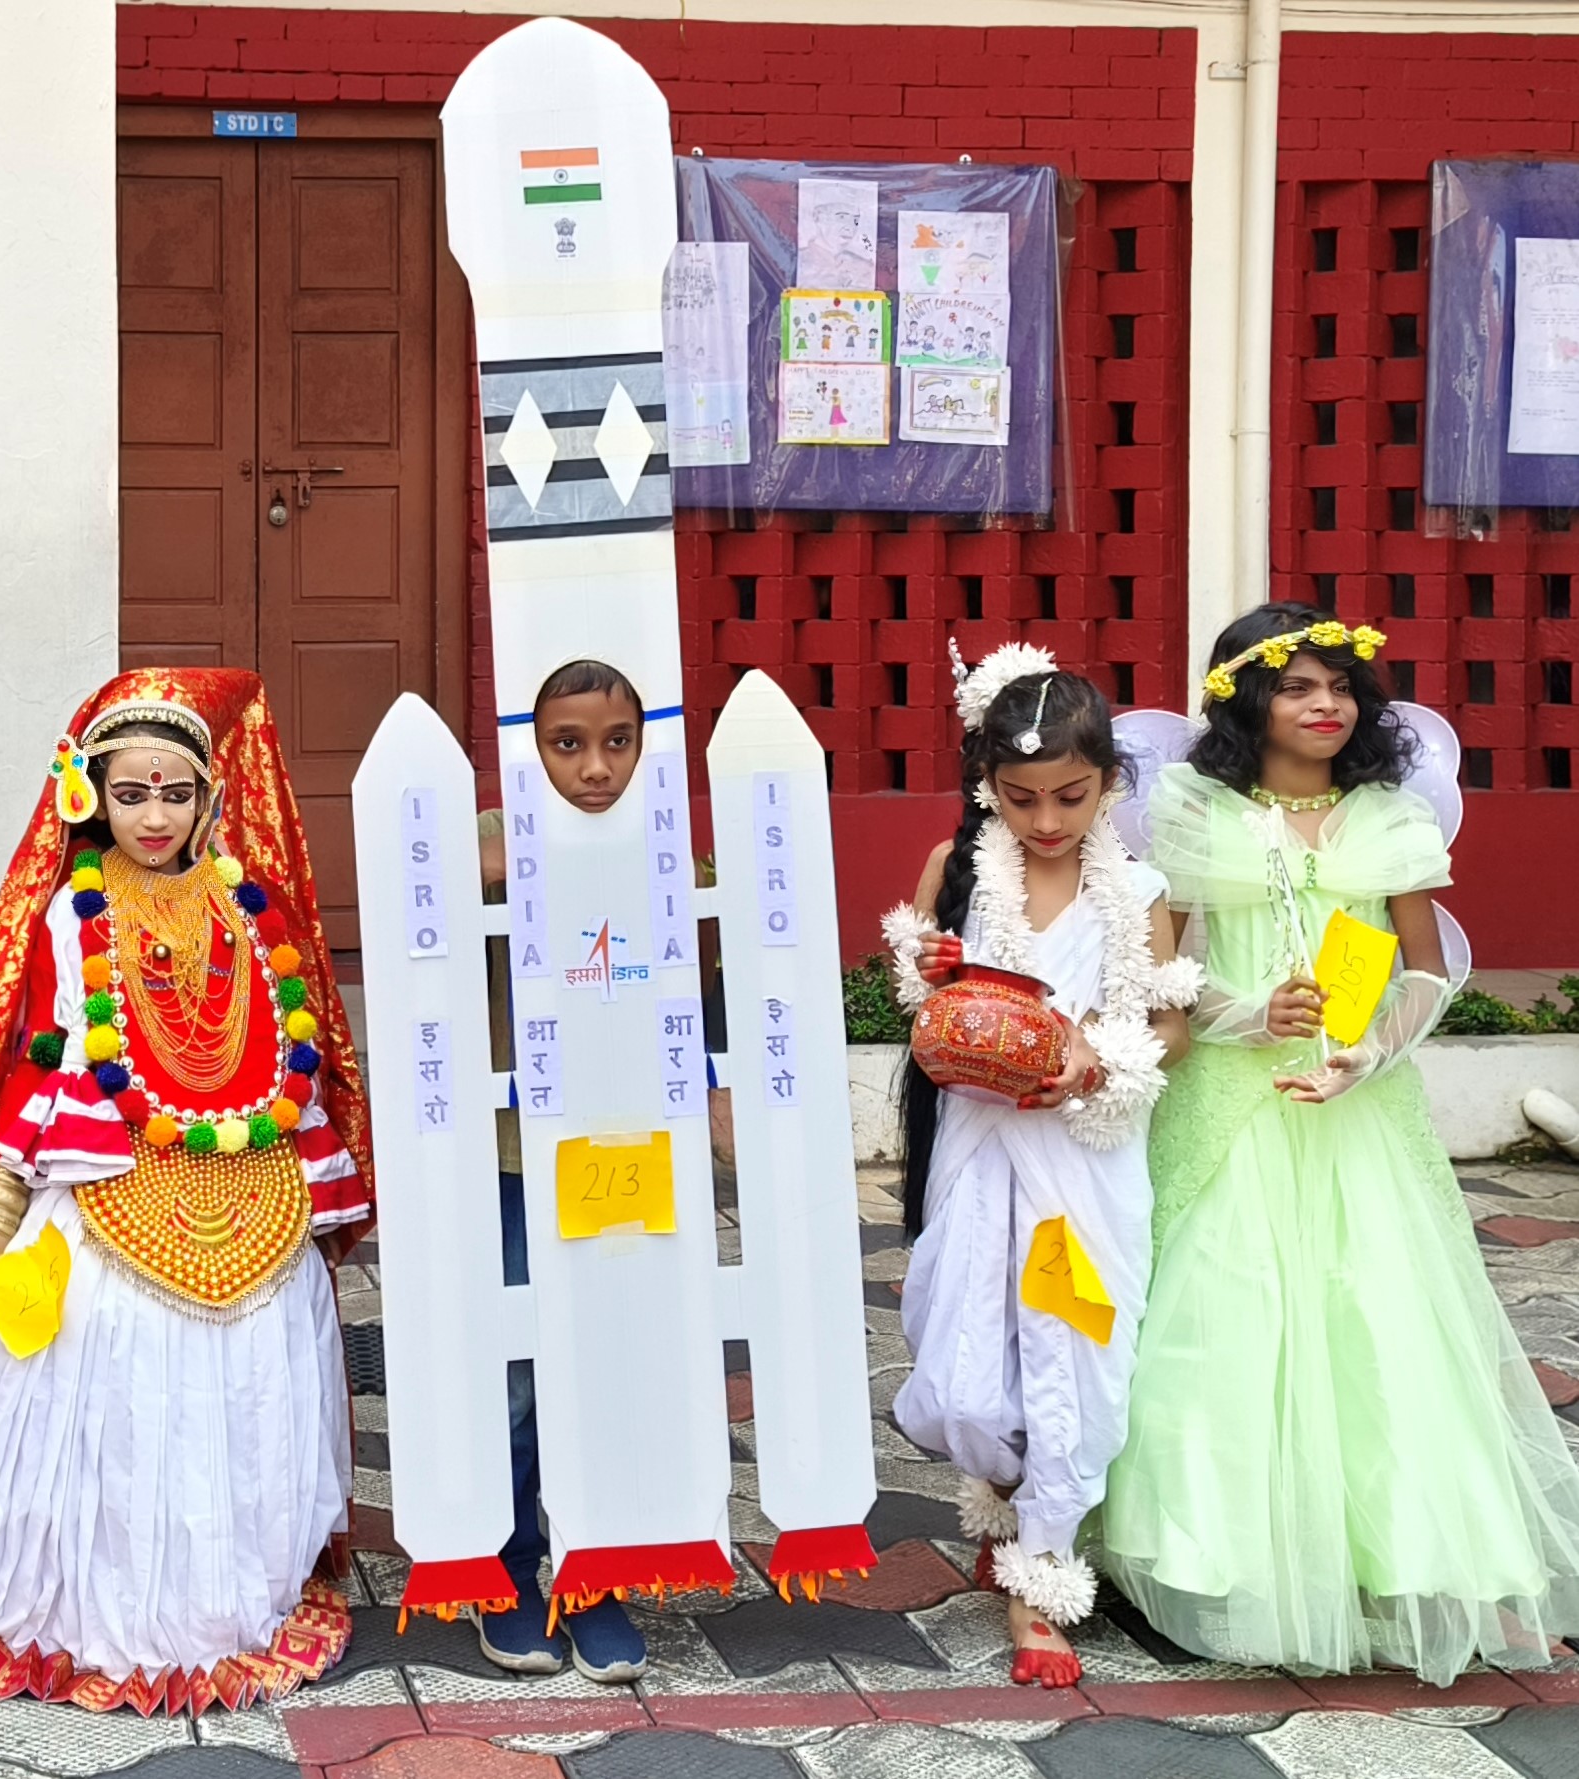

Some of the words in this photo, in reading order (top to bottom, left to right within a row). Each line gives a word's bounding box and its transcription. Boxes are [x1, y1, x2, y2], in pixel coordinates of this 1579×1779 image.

[227, 114, 258, 131] STD
[273, 115, 284, 132] C
[412, 798, 438, 949] ISRO
[514, 770, 542, 966] INDIA
[655, 767, 683, 960] INDIA
[766, 783, 789, 933] ISRO
[564, 963, 602, 986] इसरो
[1328, 941, 1366, 1007] 205
[419, 1022, 448, 1125] इसरो
[527, 1019, 558, 1109] भारत
[664, 1014, 694, 1103] भारत
[580, 1162, 641, 1202] 213
[13, 1256, 61, 1317] 215
